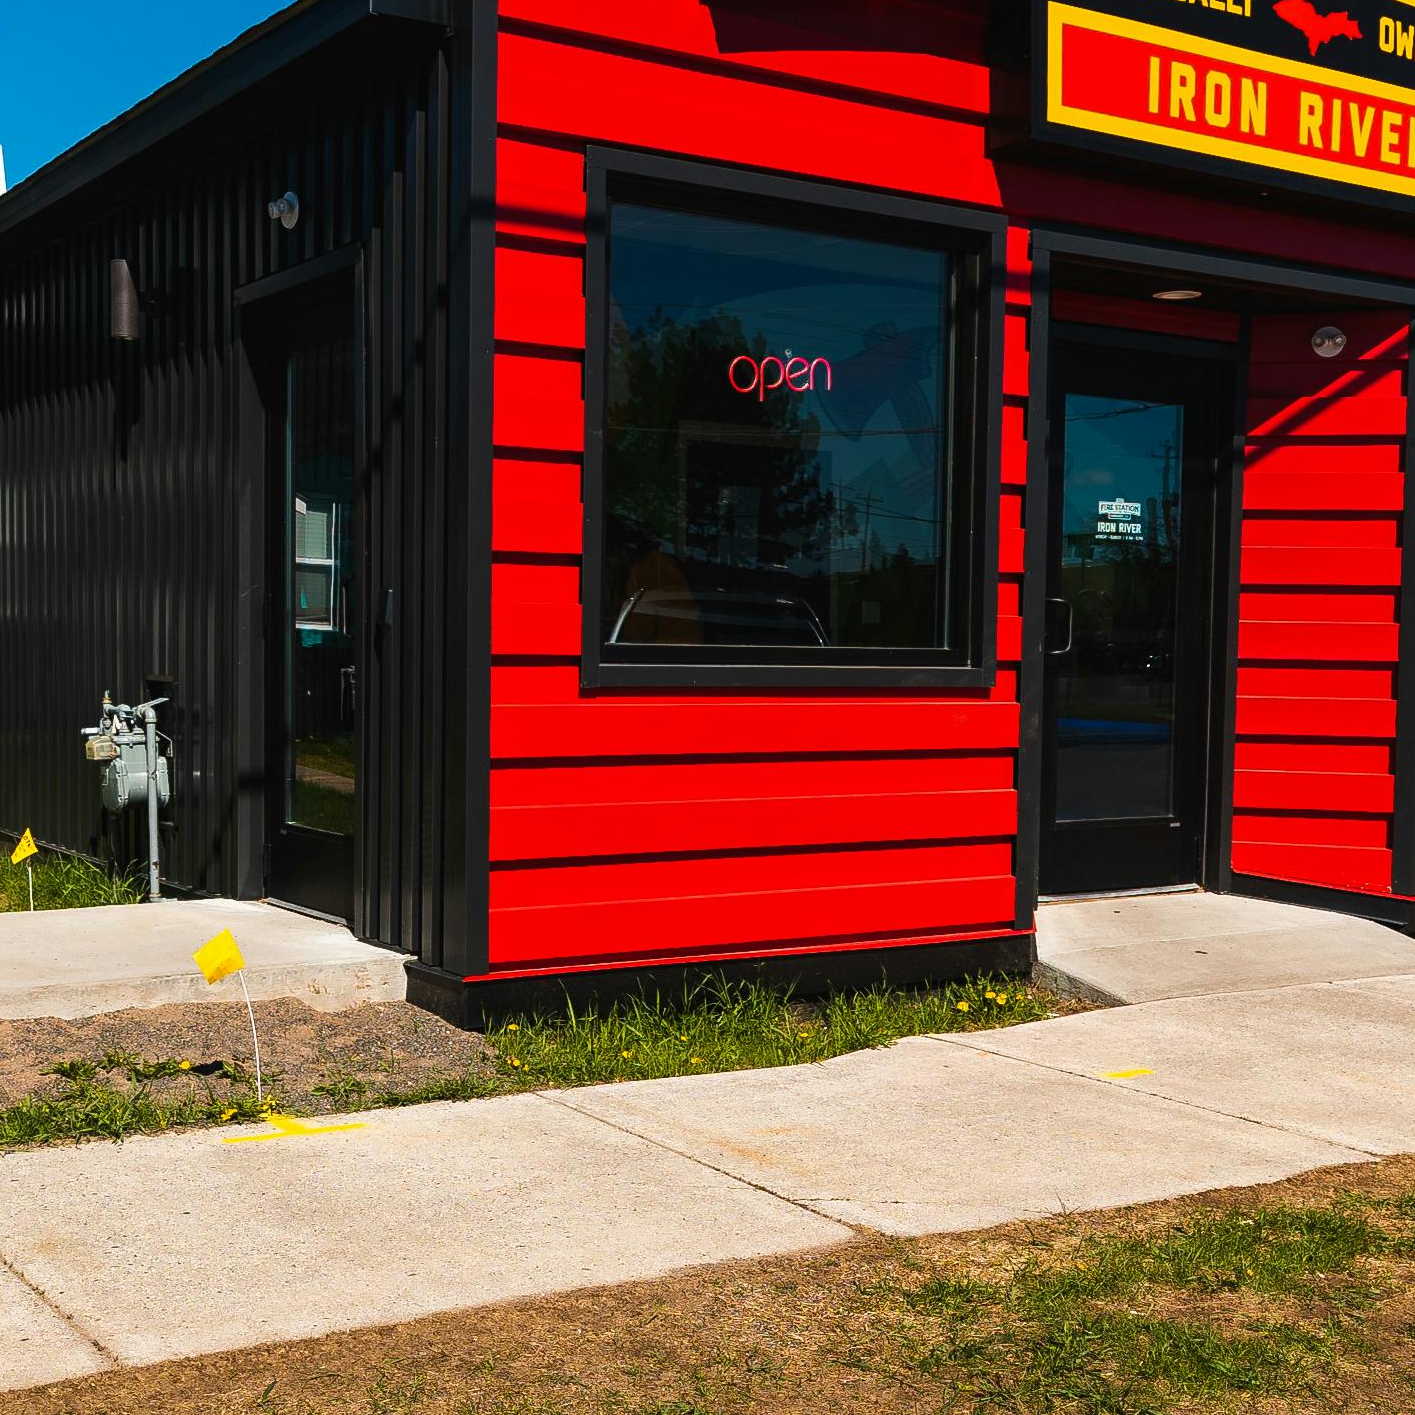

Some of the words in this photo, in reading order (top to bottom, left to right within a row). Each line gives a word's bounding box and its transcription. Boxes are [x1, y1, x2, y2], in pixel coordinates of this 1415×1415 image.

[1148, 55, 1268, 137] IRON
[728, 354, 833, 402] open
[1097, 522, 1116, 532] IRON
[1119, 523, 1141, 534] RIVER
